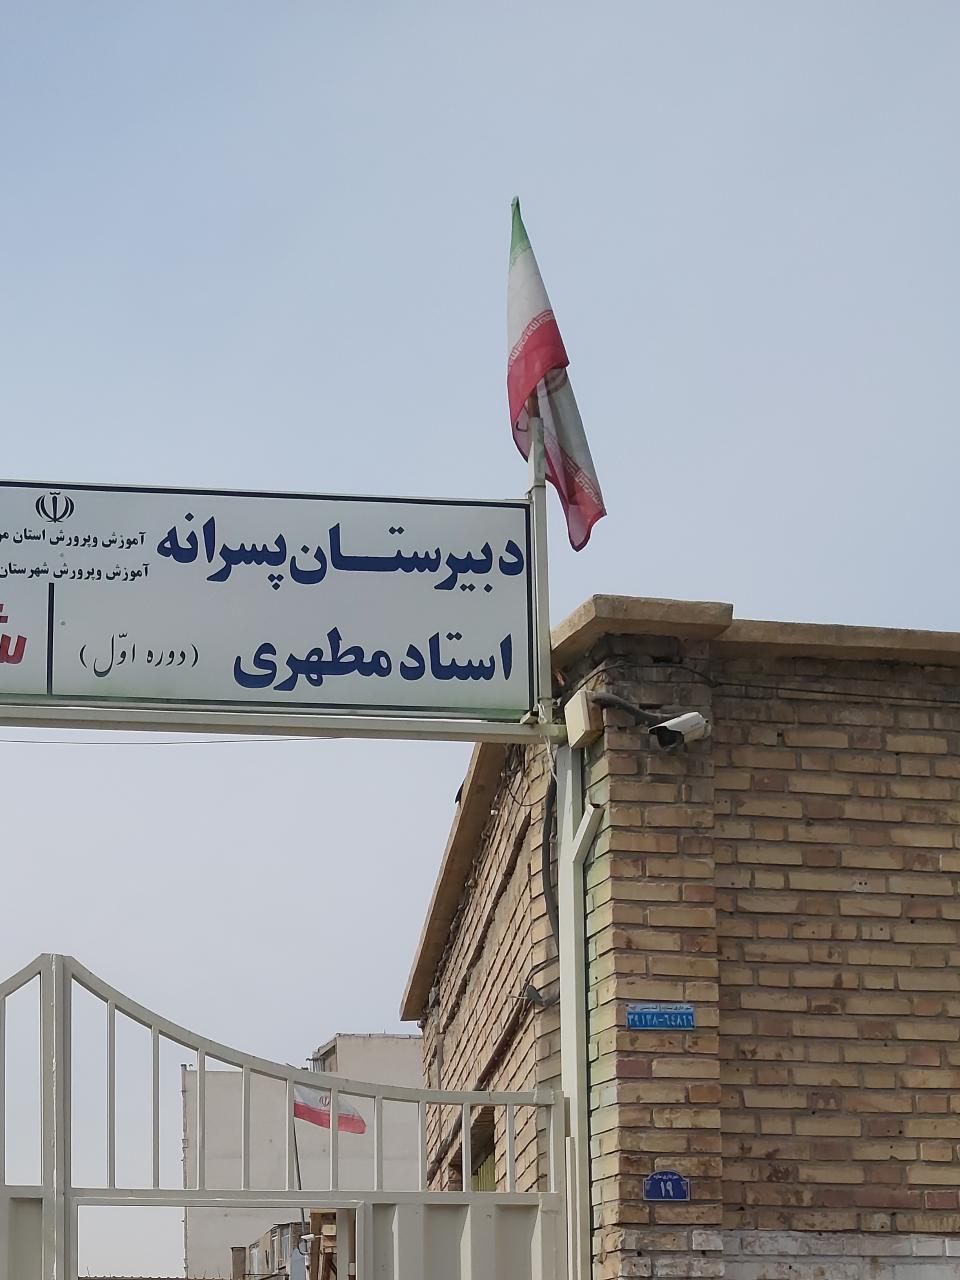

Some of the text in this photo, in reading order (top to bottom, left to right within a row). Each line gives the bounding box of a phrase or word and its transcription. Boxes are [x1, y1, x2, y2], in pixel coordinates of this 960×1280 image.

[12, 527, 46, 545] استان
[101, 530, 147, 550] آموزش
[156, 511, 525, 594] دبیرستان پسرانه
[105, 562, 151, 582] آموزش
[146, 643, 199, 668] (دوره
[233, 626, 513, 692] استاد مطهری
